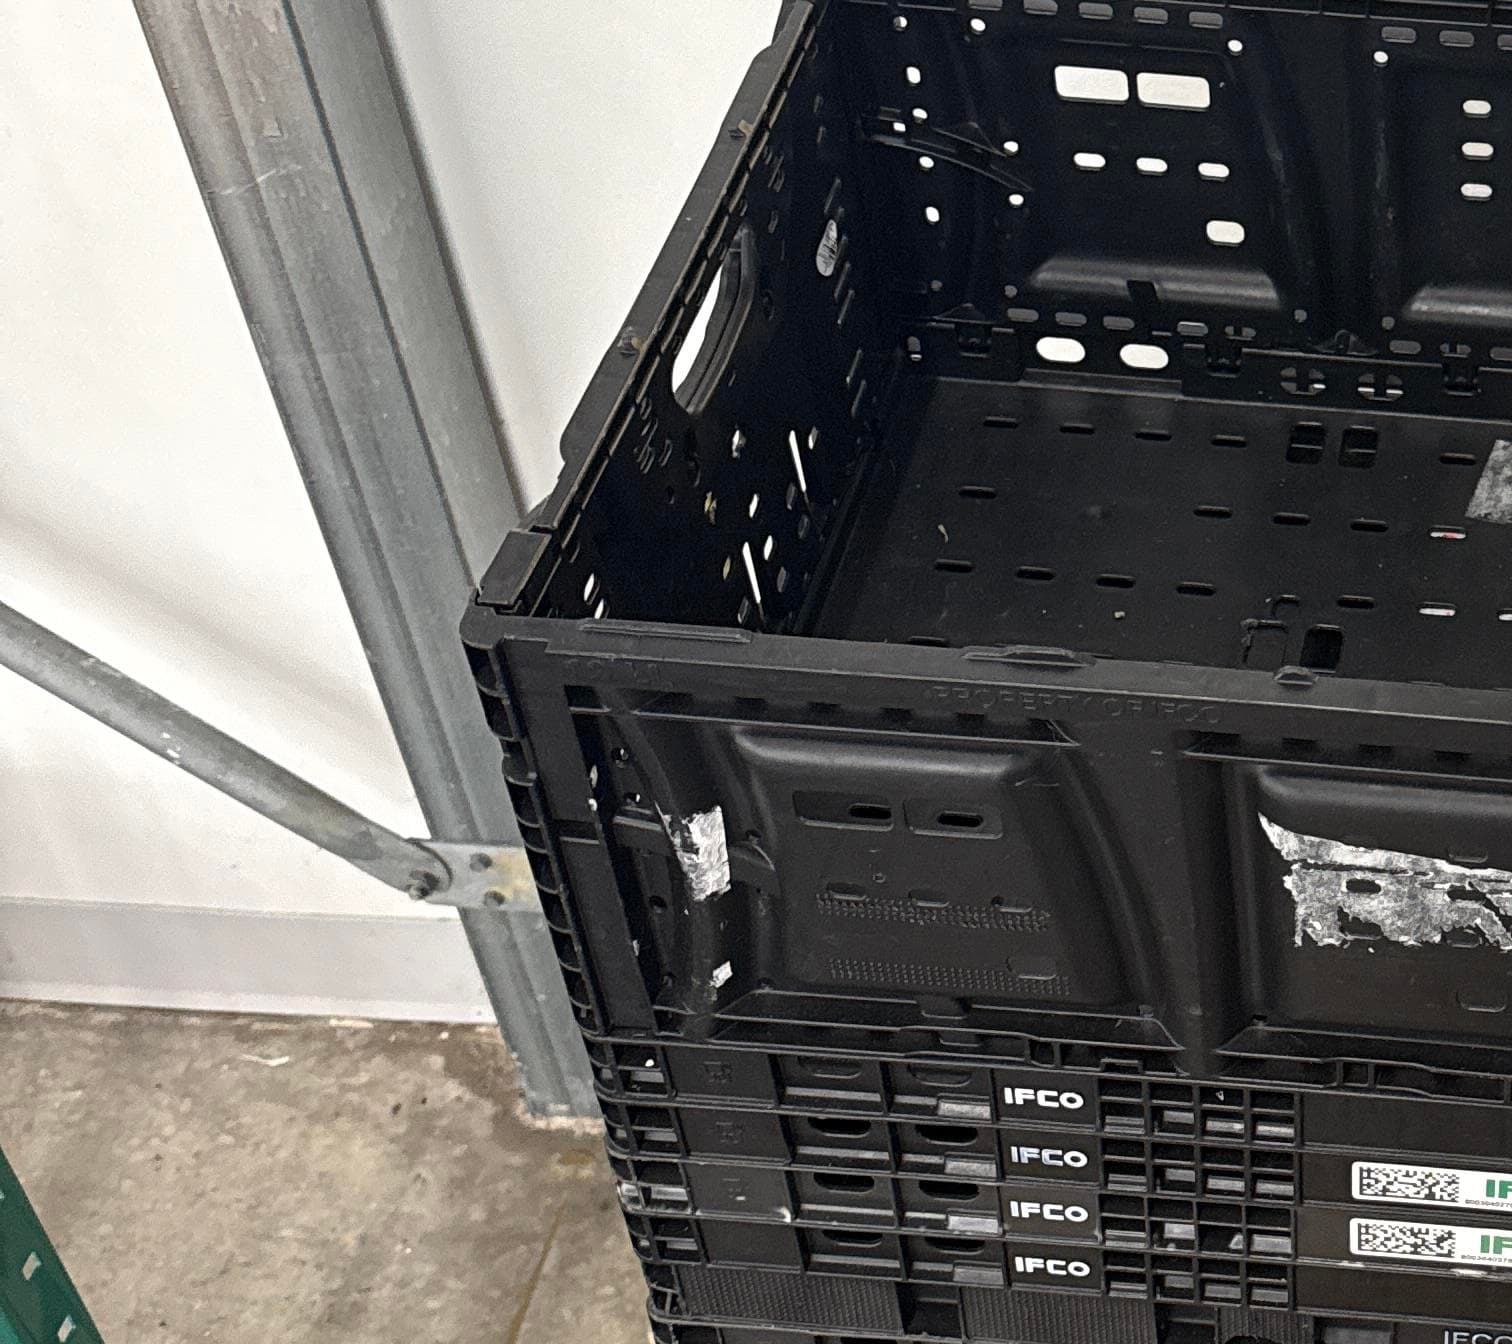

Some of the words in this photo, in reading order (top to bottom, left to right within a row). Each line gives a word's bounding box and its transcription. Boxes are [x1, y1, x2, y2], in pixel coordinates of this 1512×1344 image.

[1004, 1087, 1084, 1109] IFCO
[1010, 1146, 1088, 1168] IFCO
[1010, 1201, 1089, 1222] IFCO
[1014, 1256, 1090, 1277] IFCO
